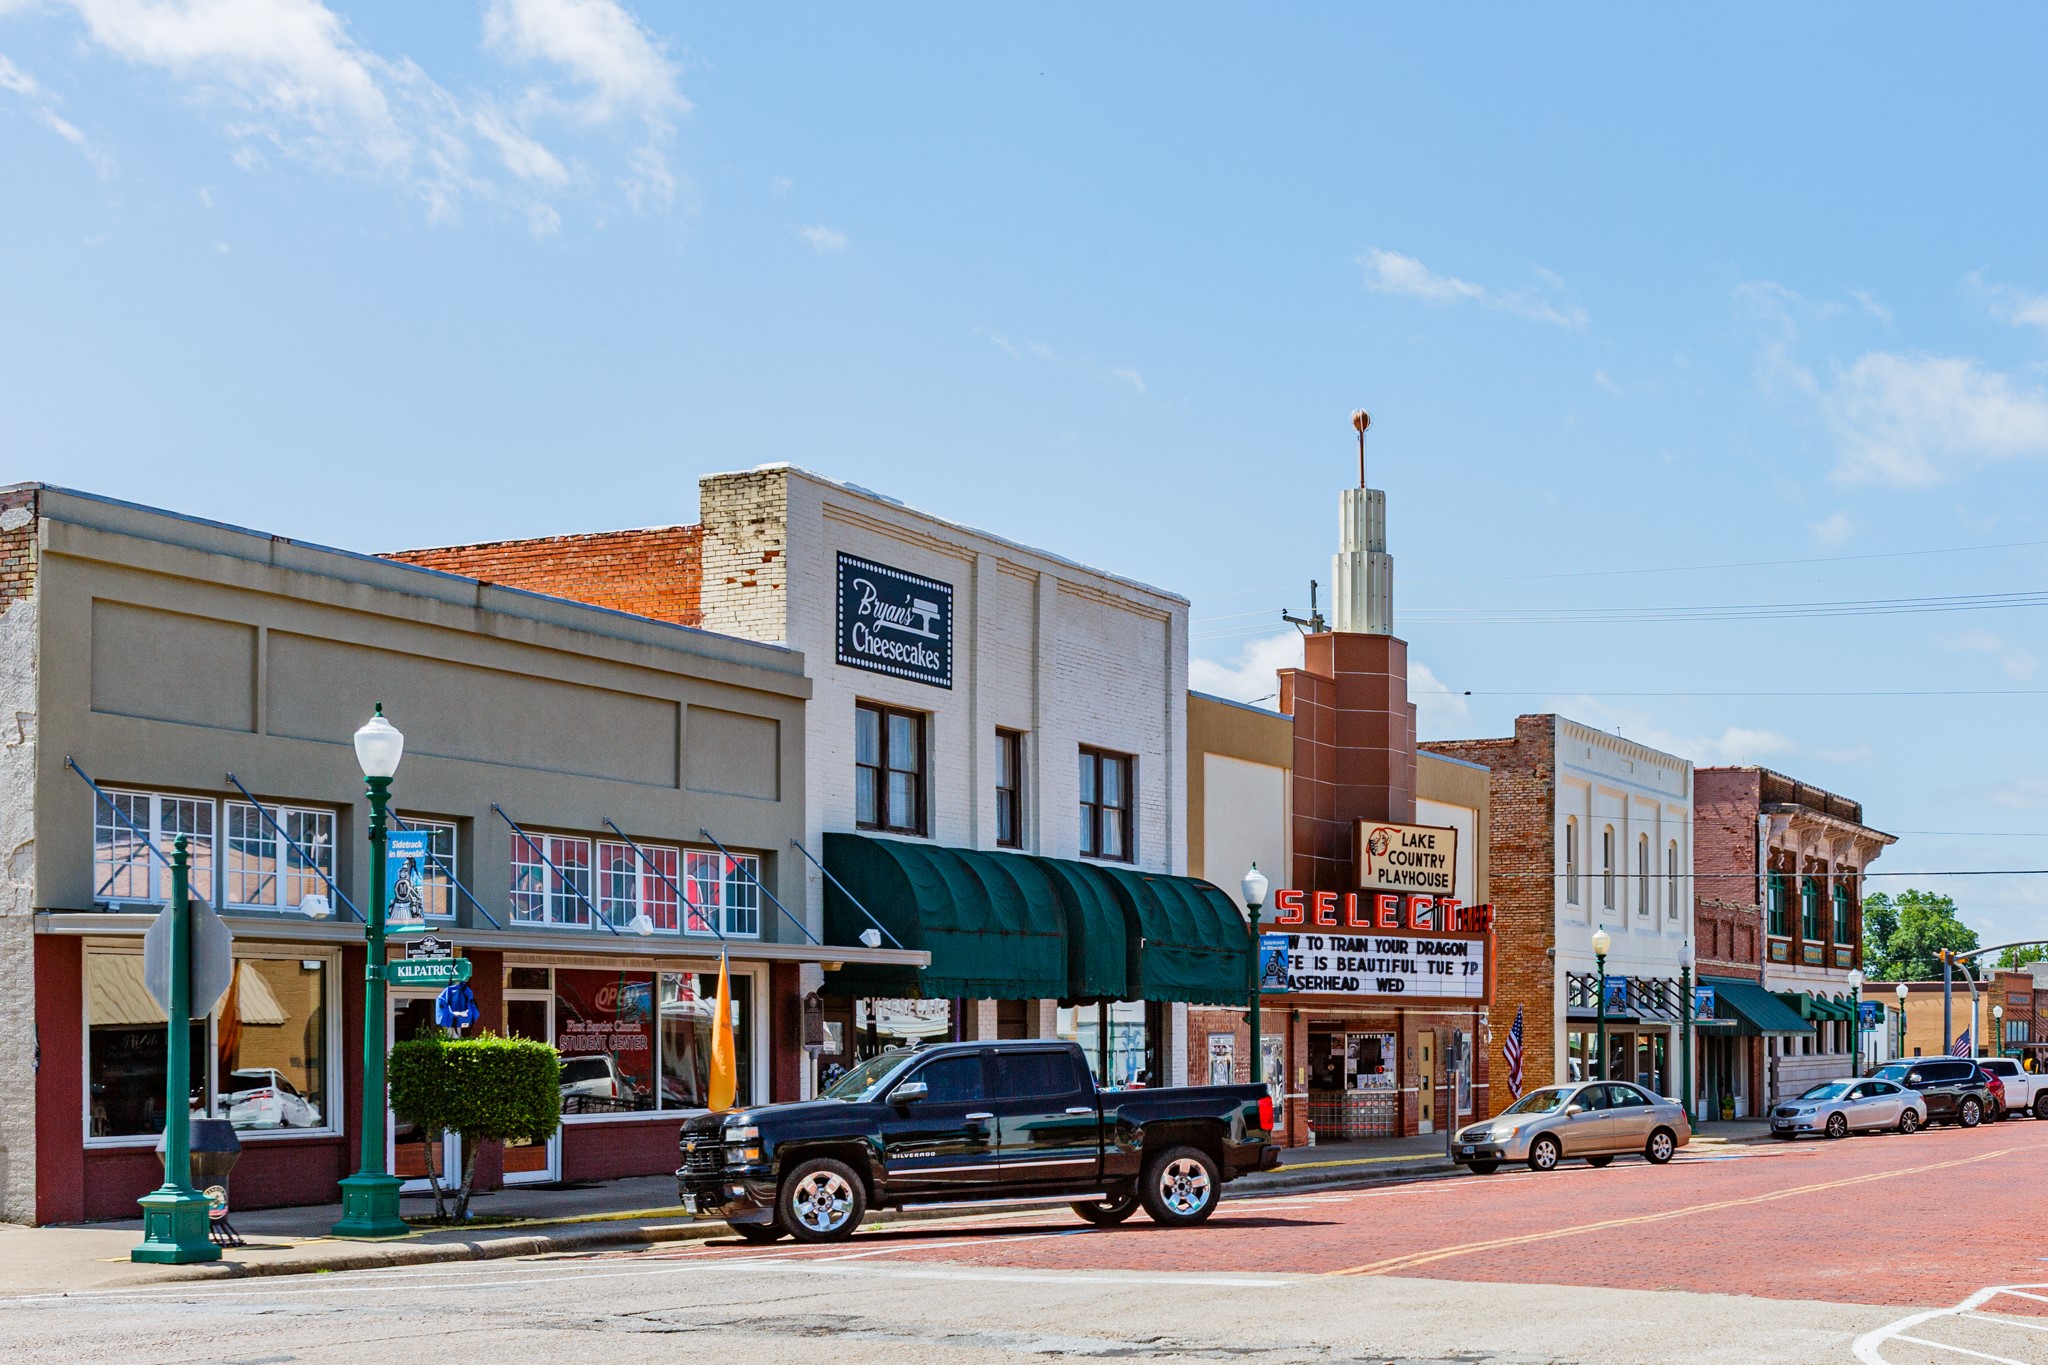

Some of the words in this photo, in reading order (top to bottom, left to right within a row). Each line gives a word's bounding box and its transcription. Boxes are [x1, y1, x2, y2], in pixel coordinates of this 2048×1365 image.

[853, 578, 914, 633] Bryan's
[852, 621, 940, 670] Cheesecakes
[392, 840, 423, 849] Sidetrack
[1401, 832, 1435, 850] LAKE
[388, 850, 396, 858] in
[1388, 850, 1446, 869] COUNTRY
[1378, 868, 1449, 888] PLAYHOUSE
[1275, 889, 1462, 932] SELECT
[1306, 936, 1324, 951] TO
[1329, 936, 1368, 953] TRAIN
[1375, 939, 1408, 954] YOUR
[1416, 941, 1468, 957] DRAGON
[397, 964, 459, 977] KILPATRICK
[1314, 956, 1328, 971] IS
[1337, 957, 1418, 974] BEAUTIFUL
[1427, 960, 1454, 975] TUE
[1462, 961, 1479, 976] 7P
[1288, 975, 1360, 991] ASERHEAD
[1376, 977, 1405, 992] WED
[566, 1019, 585, 1032] First
[586, 1019, 613, 1035] Baptist
[614, 1019, 641, 1032] Church
[559, 1034, 607, 1051] STUDENT
[608, 1034, 648, 1051] CENTER
[892, 1151, 936, 1159] SILVERADO
